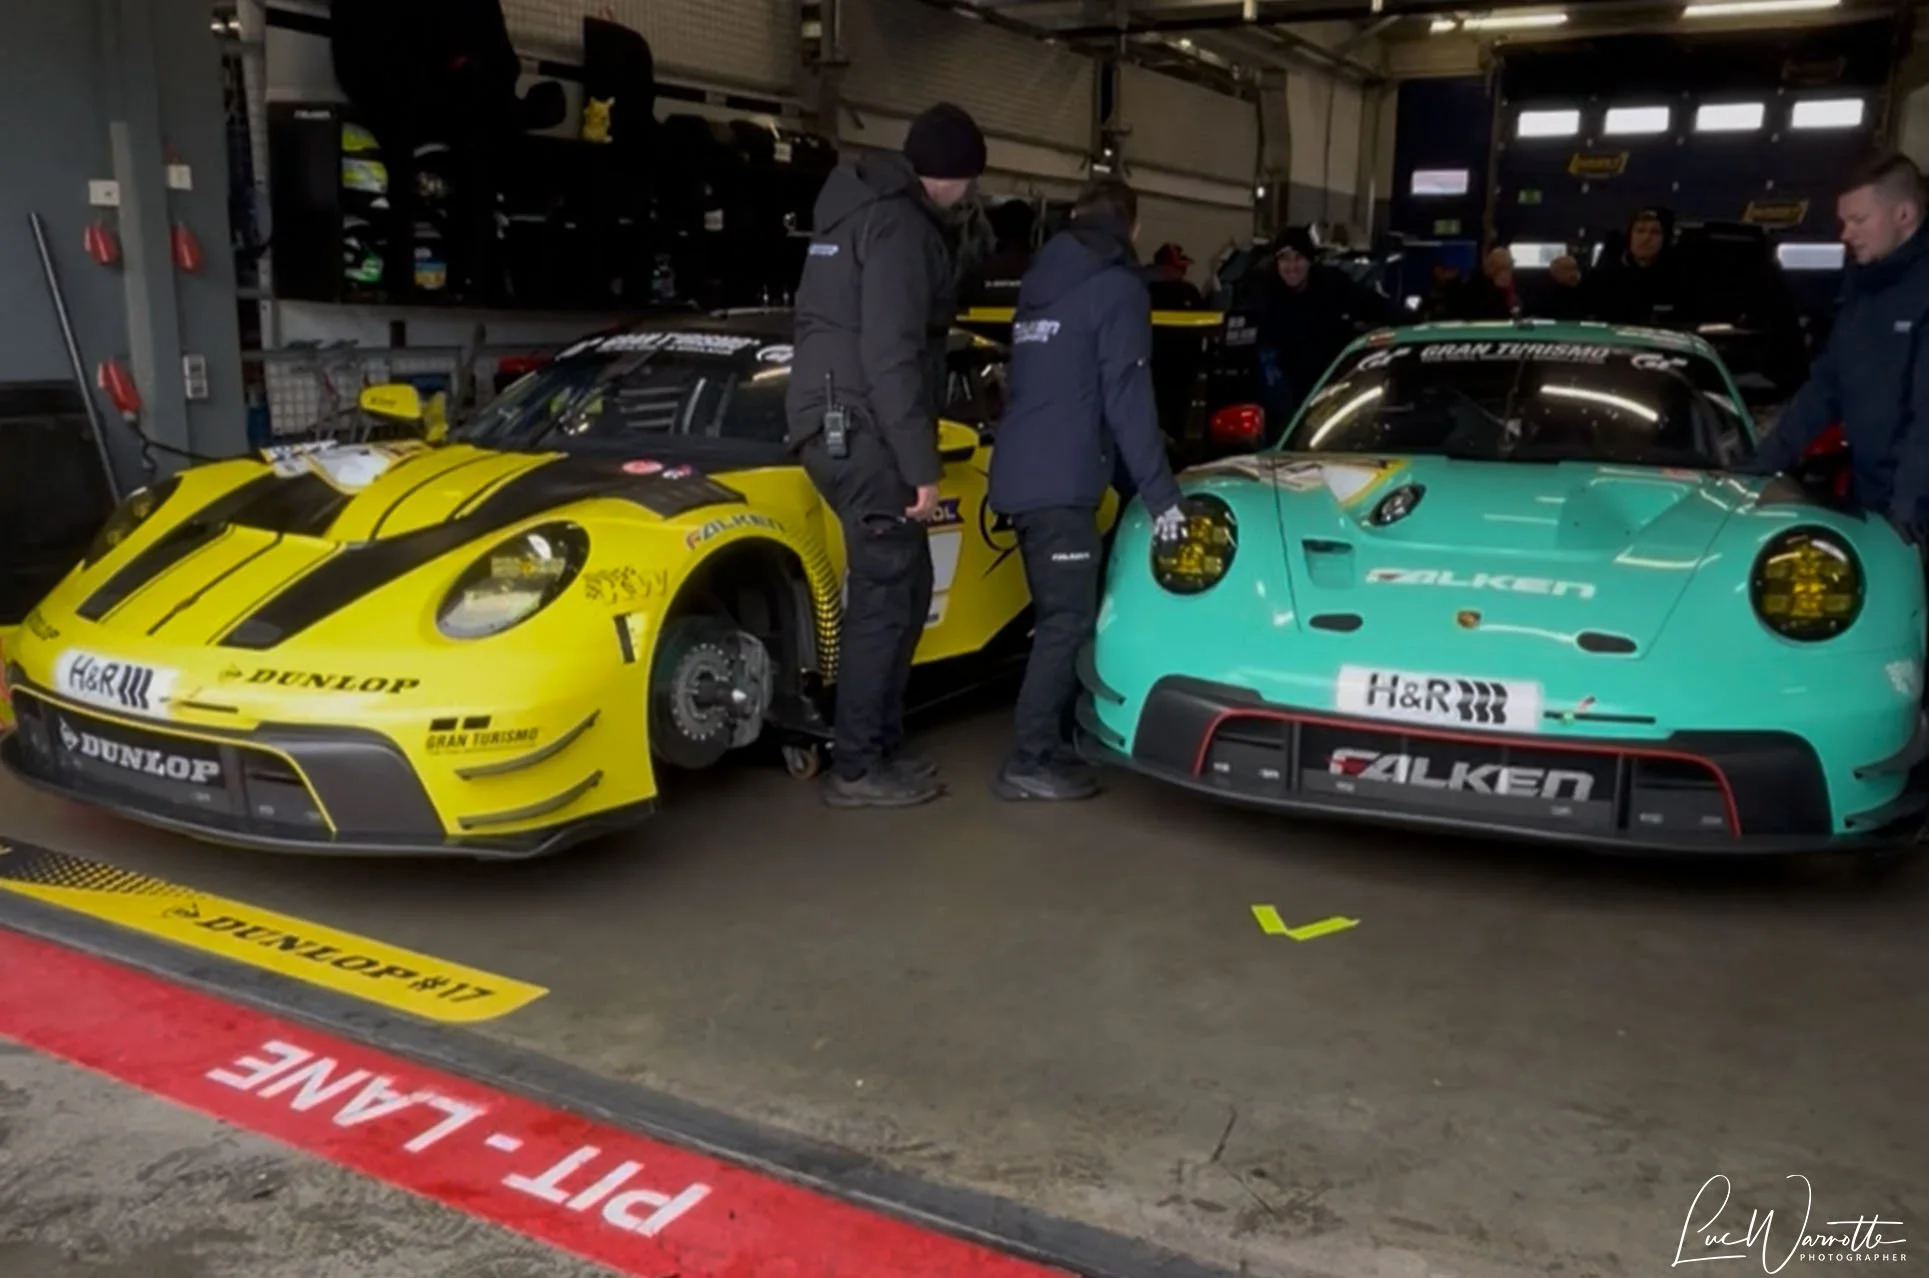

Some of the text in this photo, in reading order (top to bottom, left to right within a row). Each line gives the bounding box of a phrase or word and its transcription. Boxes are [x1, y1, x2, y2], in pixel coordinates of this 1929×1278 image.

[1421, 342, 1493, 357] GRAN
[1498, 342, 1611, 360] TURISMO
[1365, 567, 1597, 599] FALKEN
[69, 653, 119, 698] H&R
[245, 667, 421, 694] DUNLOP
[1366, 672, 1450, 714] H&R
[80, 731, 221, 783] DUNLOP
[425, 727, 539, 750] GRAN TURISMO
[1325, 747, 1595, 802] FALKEN
[195, 915, 419, 979] DUNLOP
[205, 1039, 489, 1152] LANE
[501, 1145, 712, 1238] PIT
